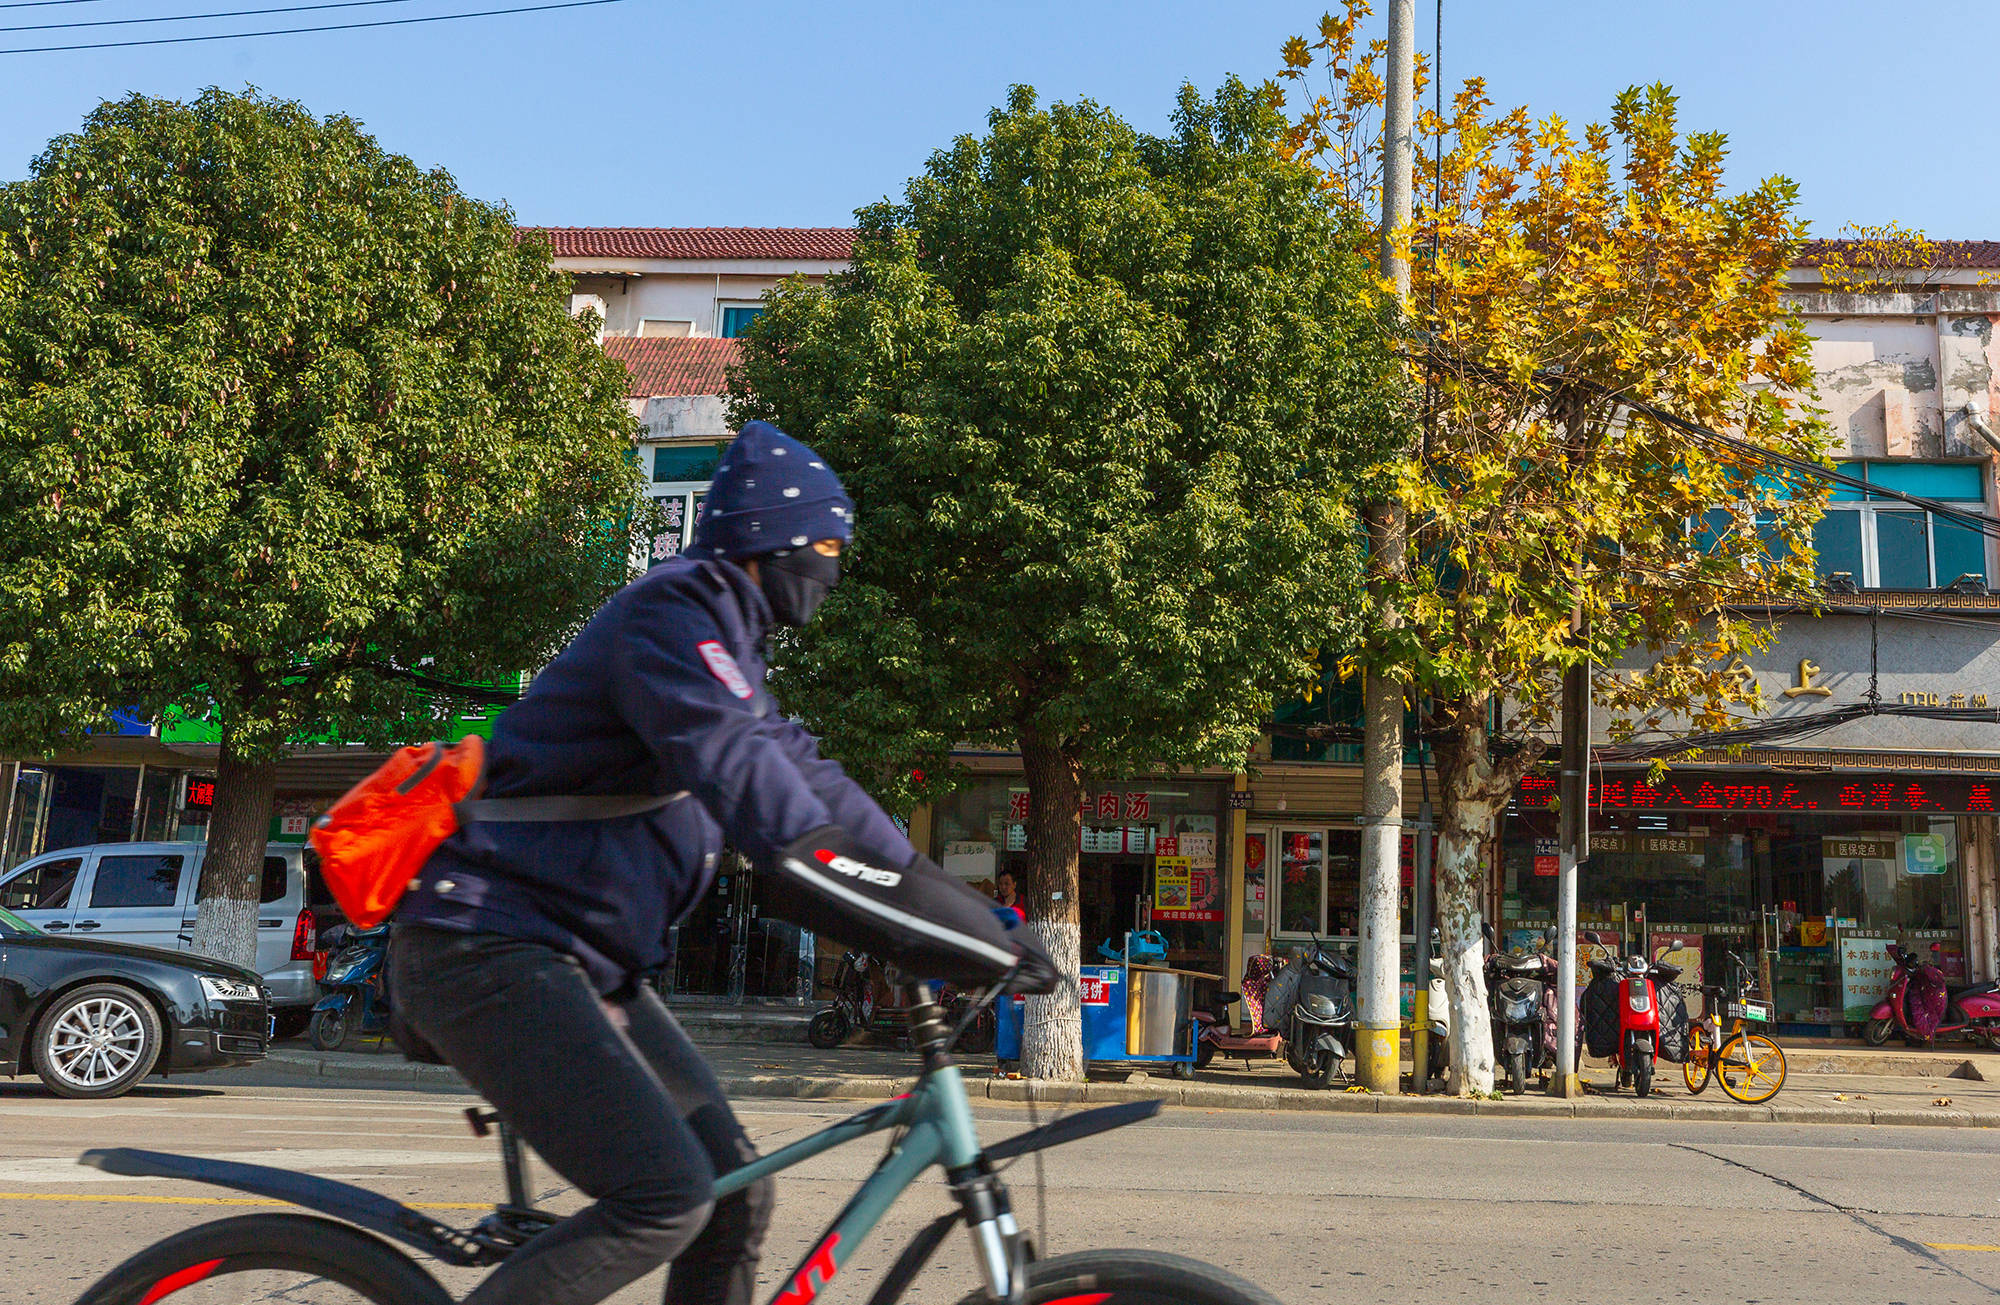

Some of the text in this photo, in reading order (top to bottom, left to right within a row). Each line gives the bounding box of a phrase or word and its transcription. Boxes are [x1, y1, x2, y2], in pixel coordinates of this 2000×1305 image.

[1649, 838, 1688, 853] 医保定点
[1839, 842, 1878, 857] 医保定点
[1162, 910, 1213, 920] 欢迎您的光临
